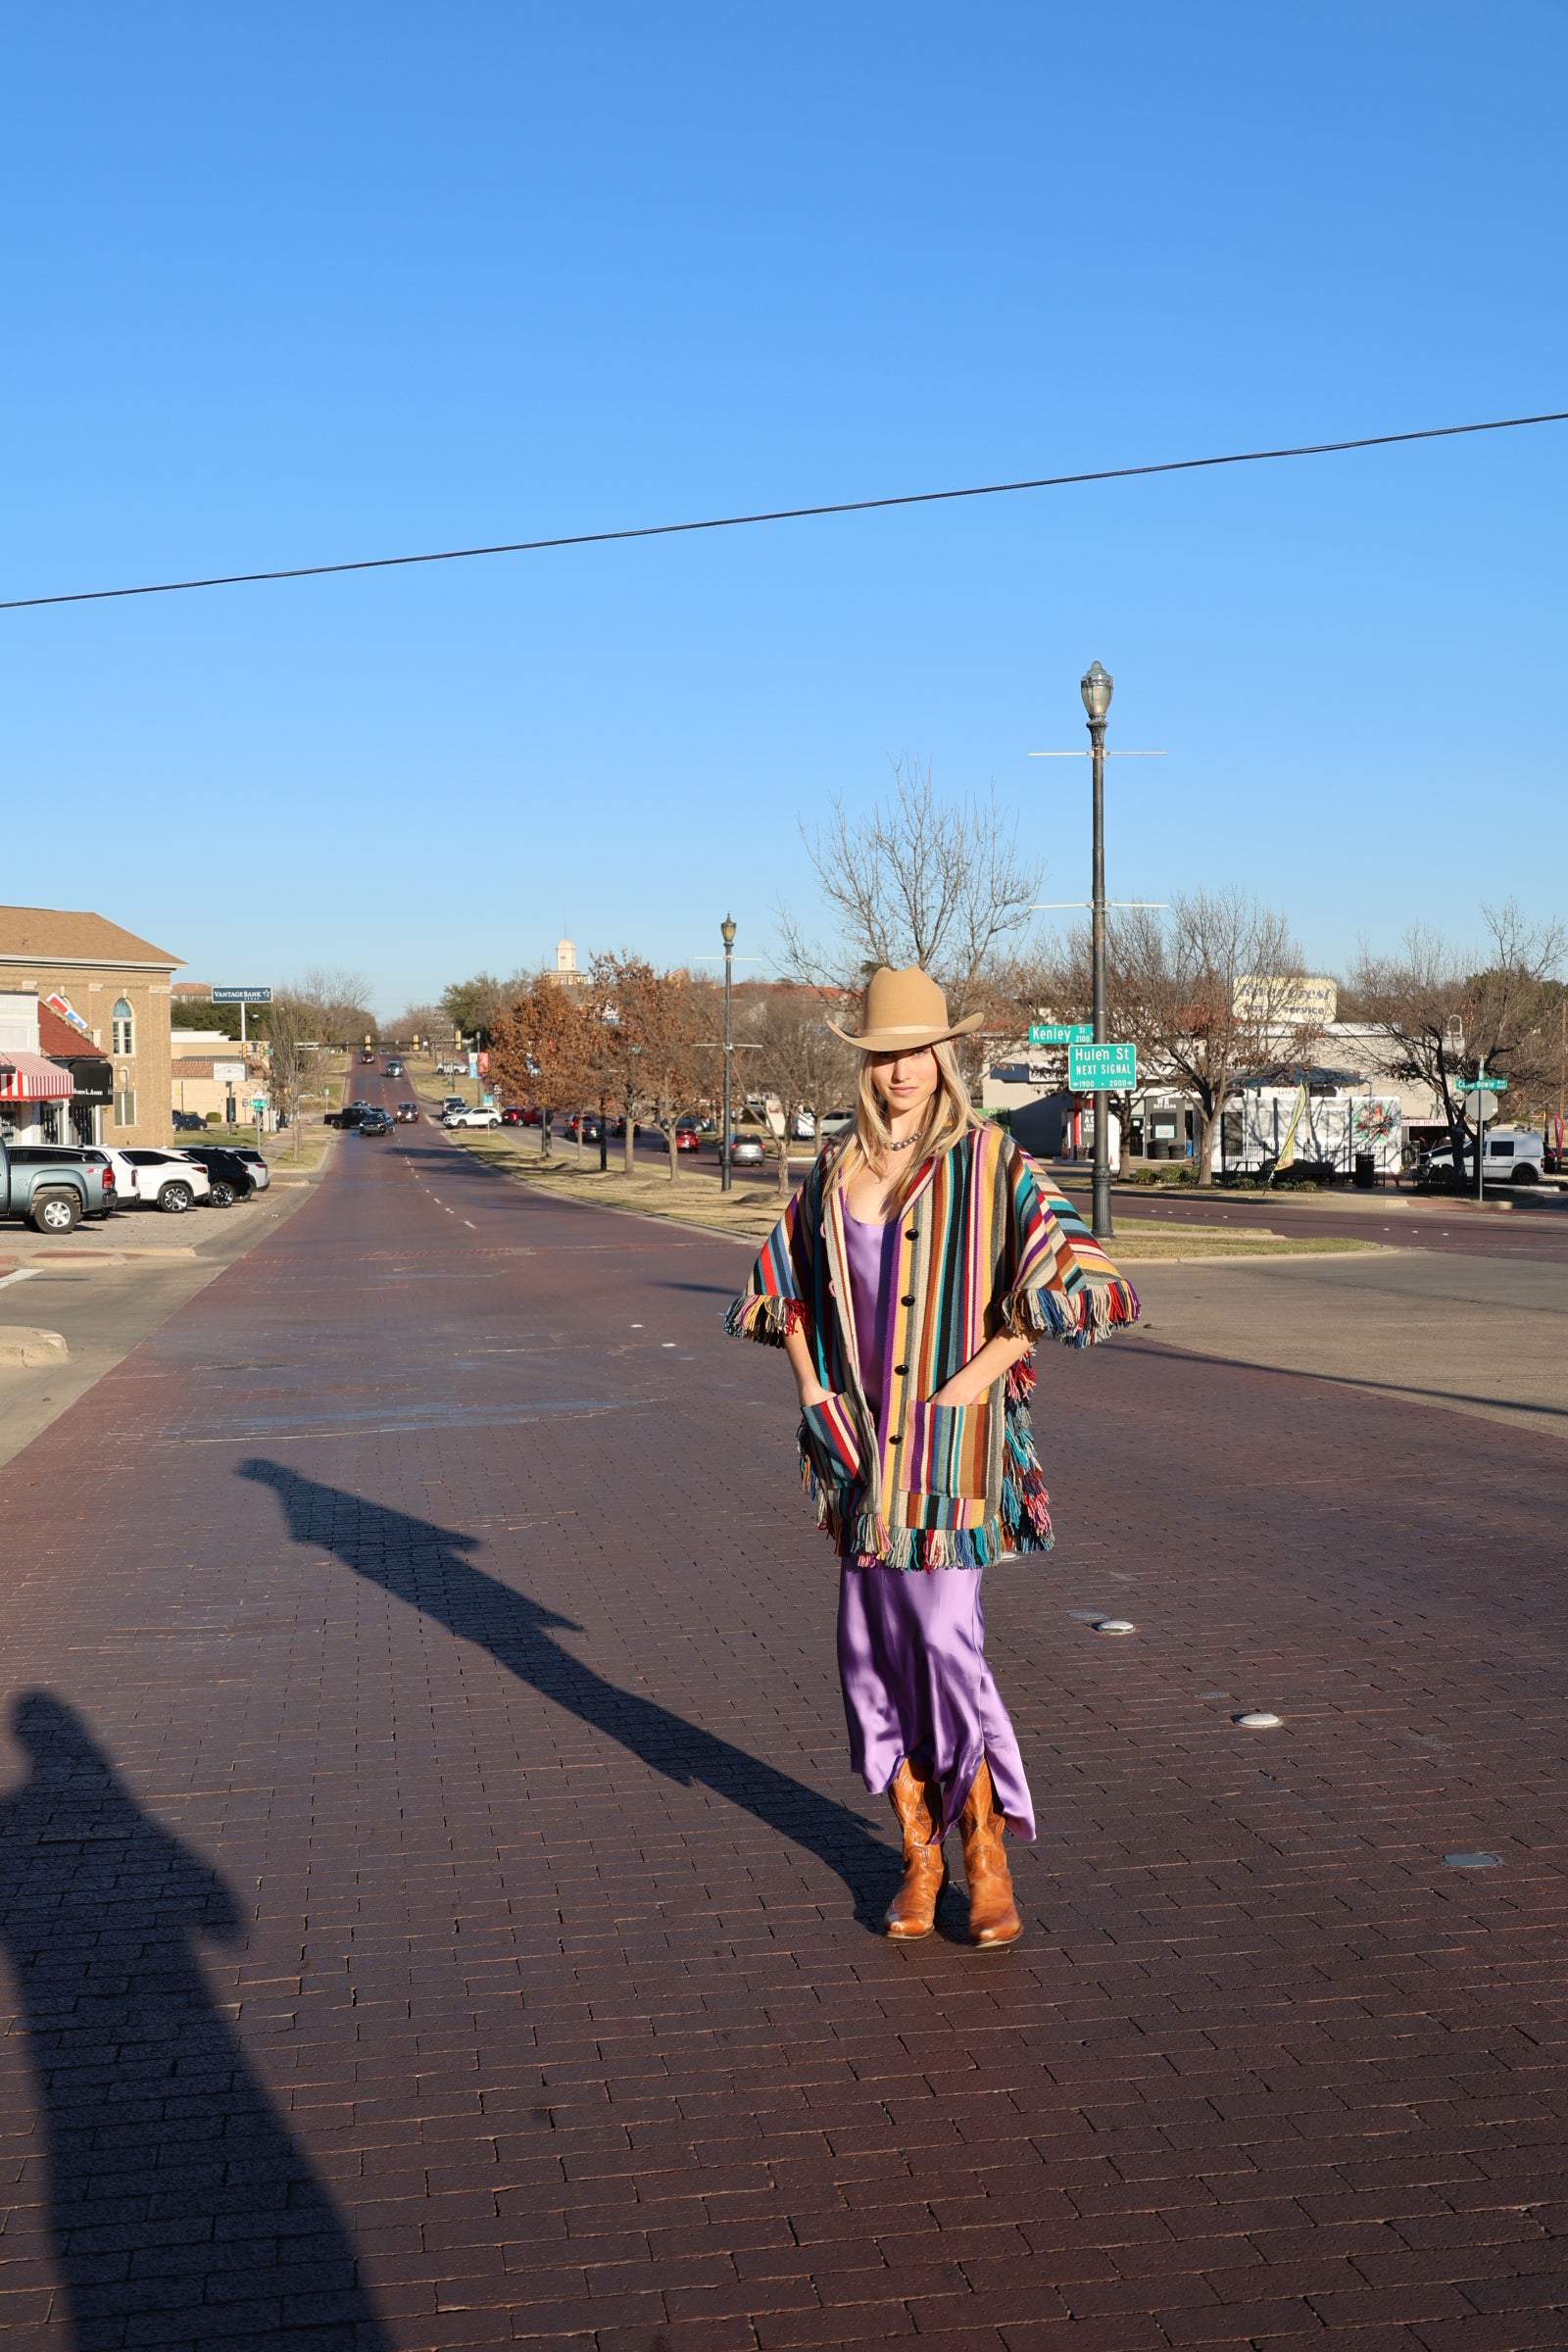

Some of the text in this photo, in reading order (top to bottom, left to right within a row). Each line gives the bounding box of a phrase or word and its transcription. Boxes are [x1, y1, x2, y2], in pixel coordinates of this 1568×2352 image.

[1033, 1027, 1071, 1043] Kenley
[1075, 1047, 1129, 1061] Hulen St
[1076, 1063, 1131, 1075] NEXT SIGNAL
